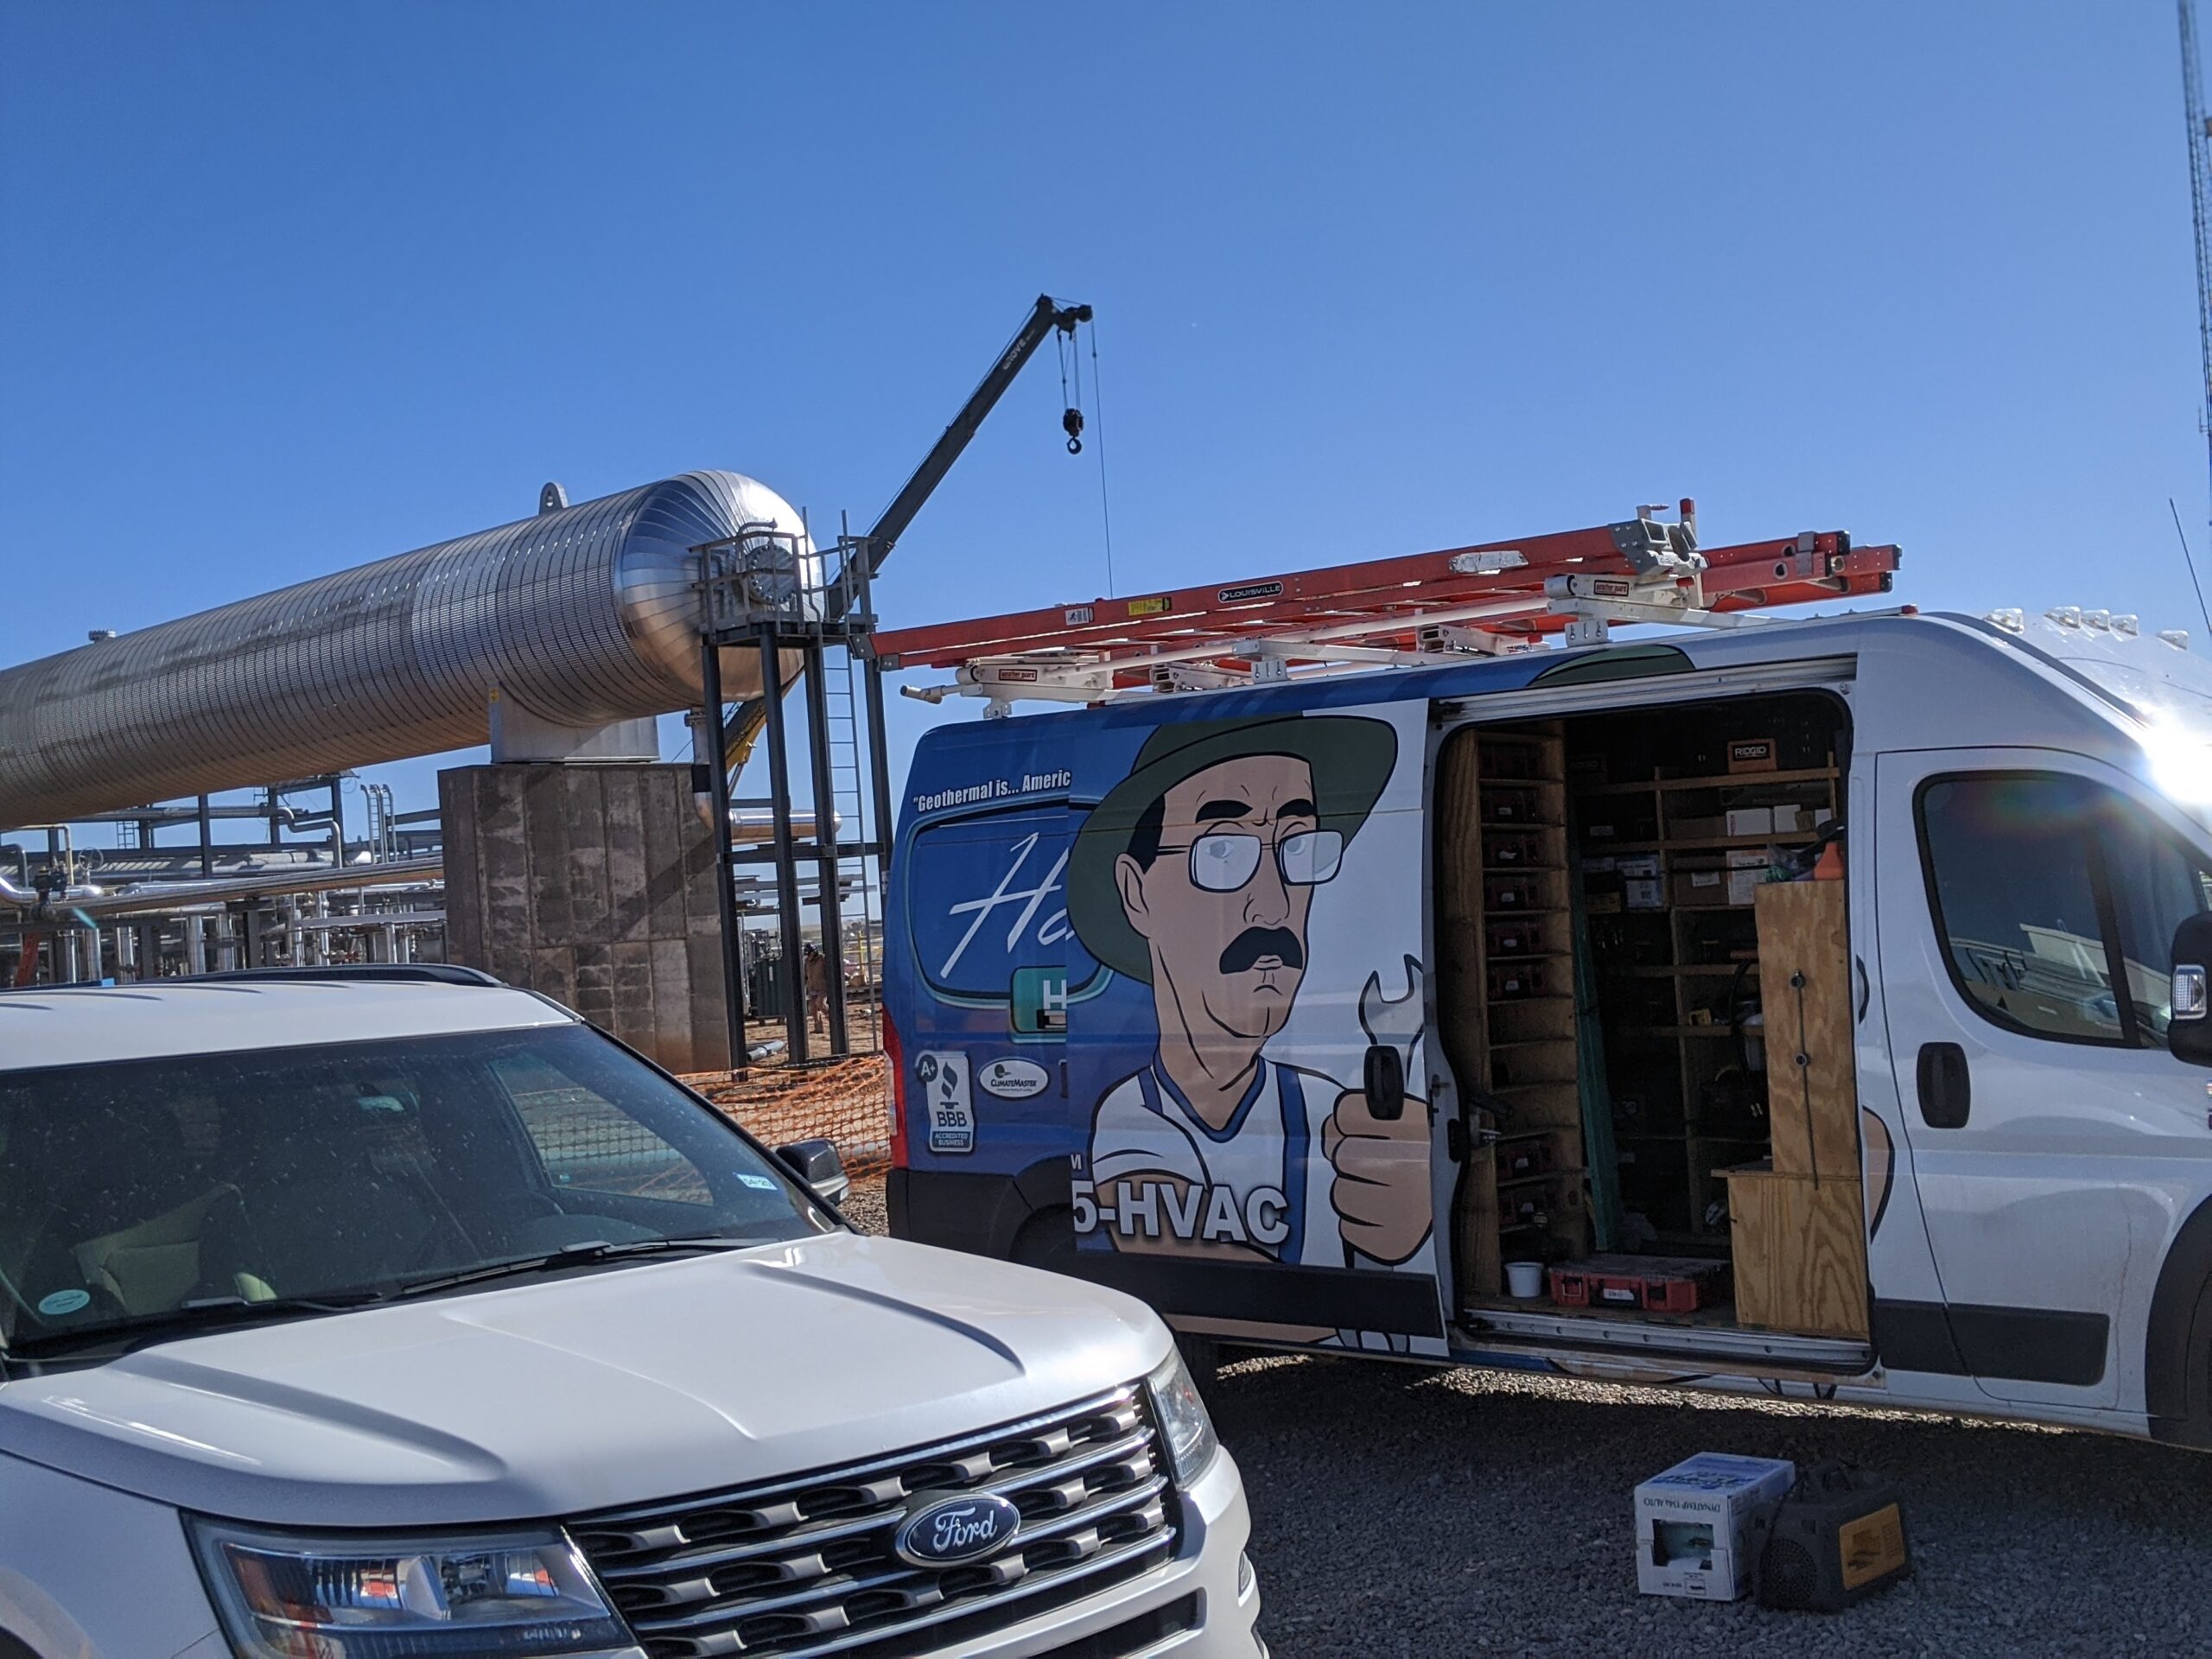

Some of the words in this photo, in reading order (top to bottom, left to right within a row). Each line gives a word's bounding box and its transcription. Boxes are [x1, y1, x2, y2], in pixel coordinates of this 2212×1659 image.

[1230, 585, 1281, 599] LOUISVILLE
[1734, 746, 1767, 757] RIDGID
[912, 780, 993, 812] "Geothermal
[995, 779, 1020, 796] is...
[1022, 770, 1071, 792] Americ
[921, 1061, 936, 1077] A+
[937, 1111, 968, 1127] BBB
[1071, 1180, 1289, 1244] 5-HVAC
[1643, 1497, 1664, 1508] AUTO
[1681, 1501, 1721, 1513] DYNATEMP
[933, 1507, 998, 1553] Ford
